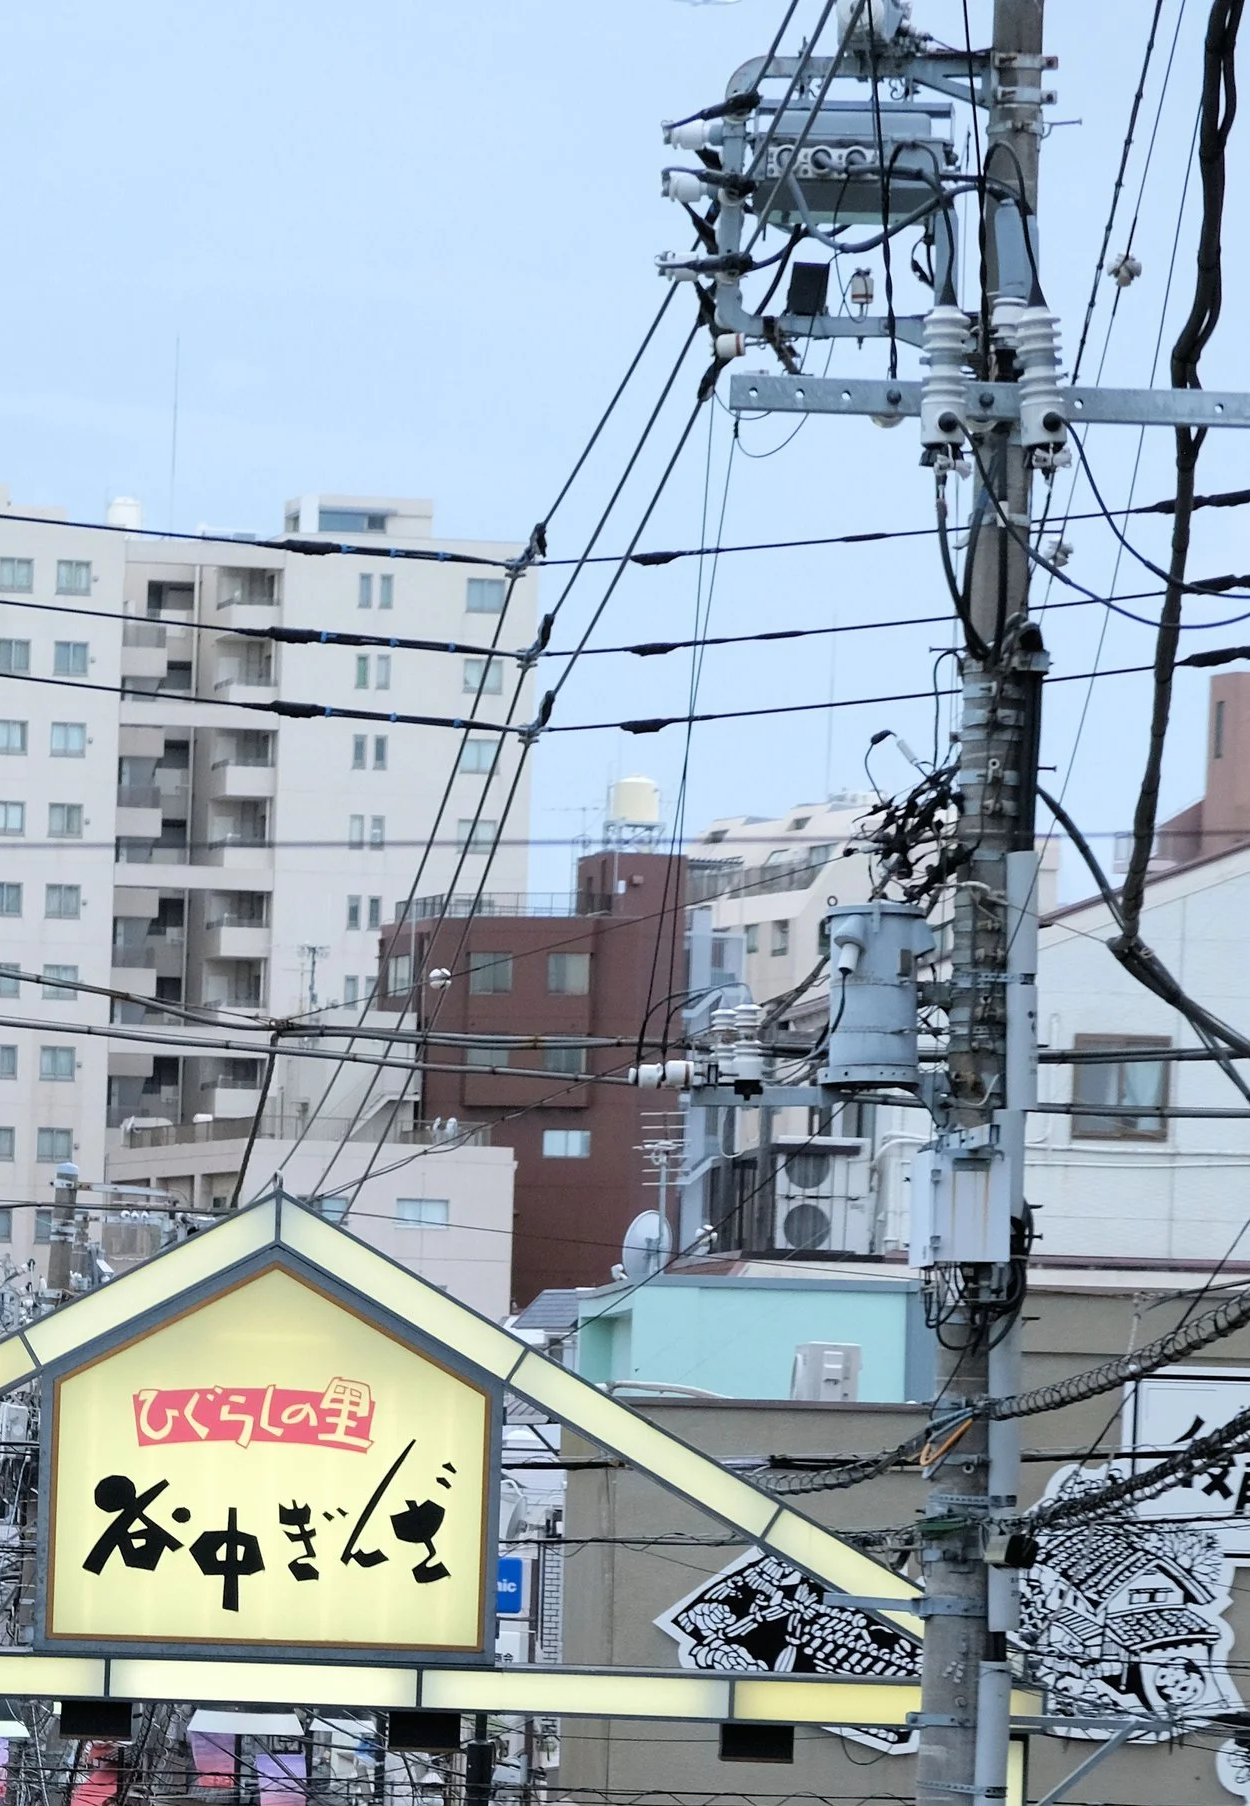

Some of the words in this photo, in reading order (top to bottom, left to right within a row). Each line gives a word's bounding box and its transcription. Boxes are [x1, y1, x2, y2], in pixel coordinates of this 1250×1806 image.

[137, 1377, 374, 1452] ひぐらしの里
[81, 1438, 457, 1613] 谷中ぎんざ
